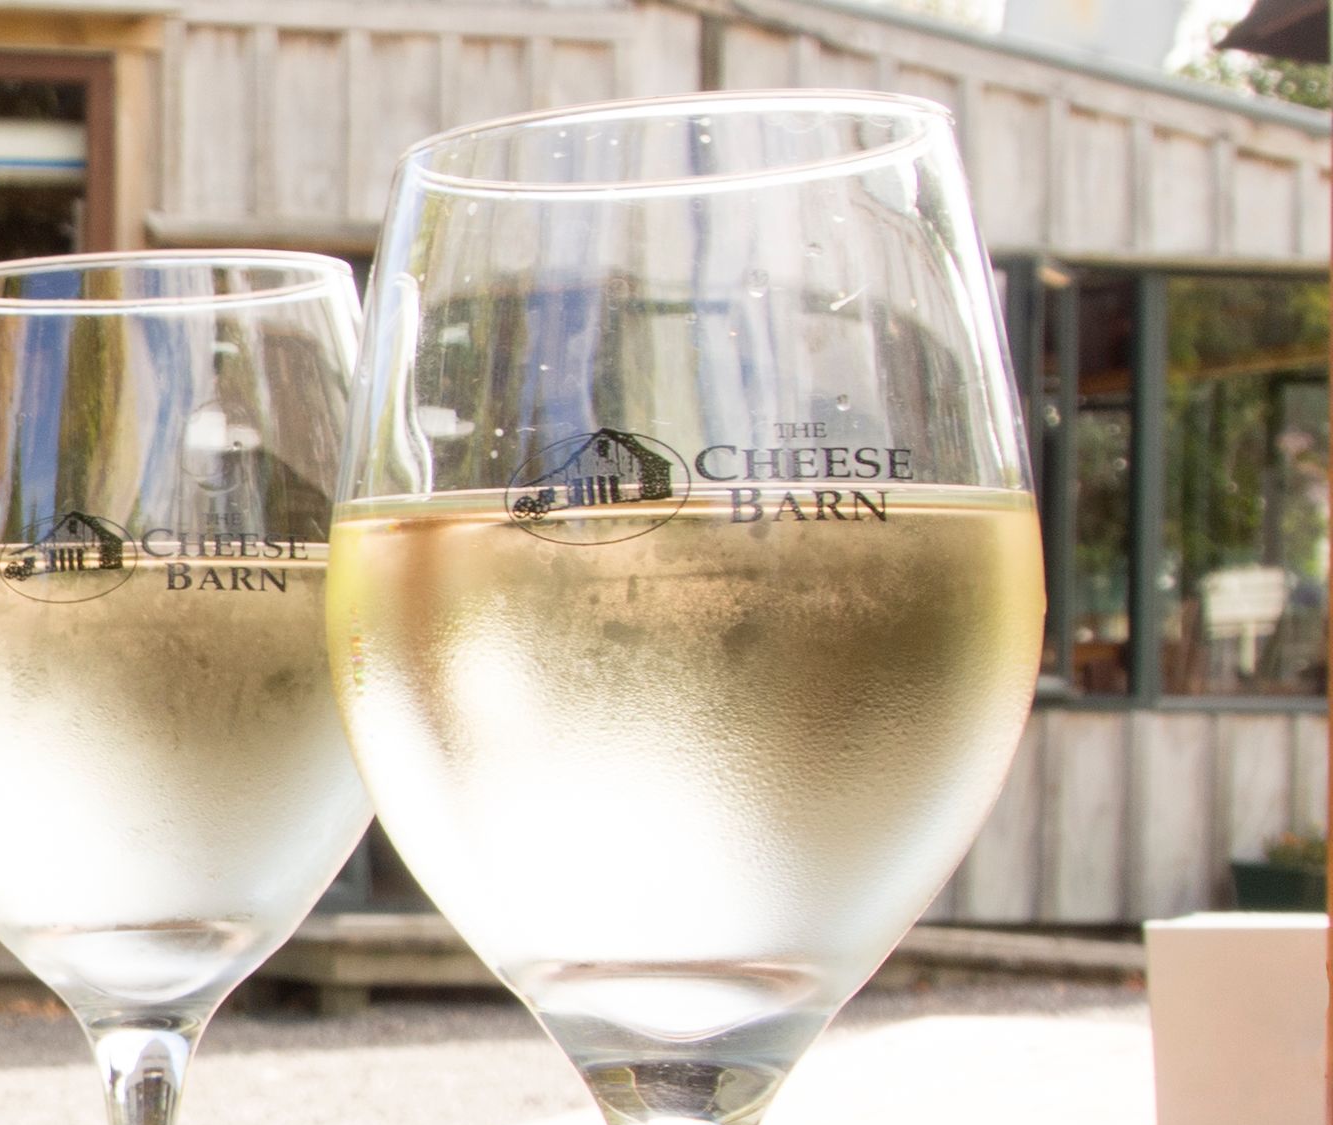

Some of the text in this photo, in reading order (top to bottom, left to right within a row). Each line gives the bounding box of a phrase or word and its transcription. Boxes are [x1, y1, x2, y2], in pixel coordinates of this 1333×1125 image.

[774, 421, 827, 439] THE
[694, 444, 914, 481] CHEESE
[203, 512, 243, 526] THE
[731, 488, 889, 523] BARN
[141, 528, 309, 560] CHEESE
[166, 562, 287, 593] BARN
